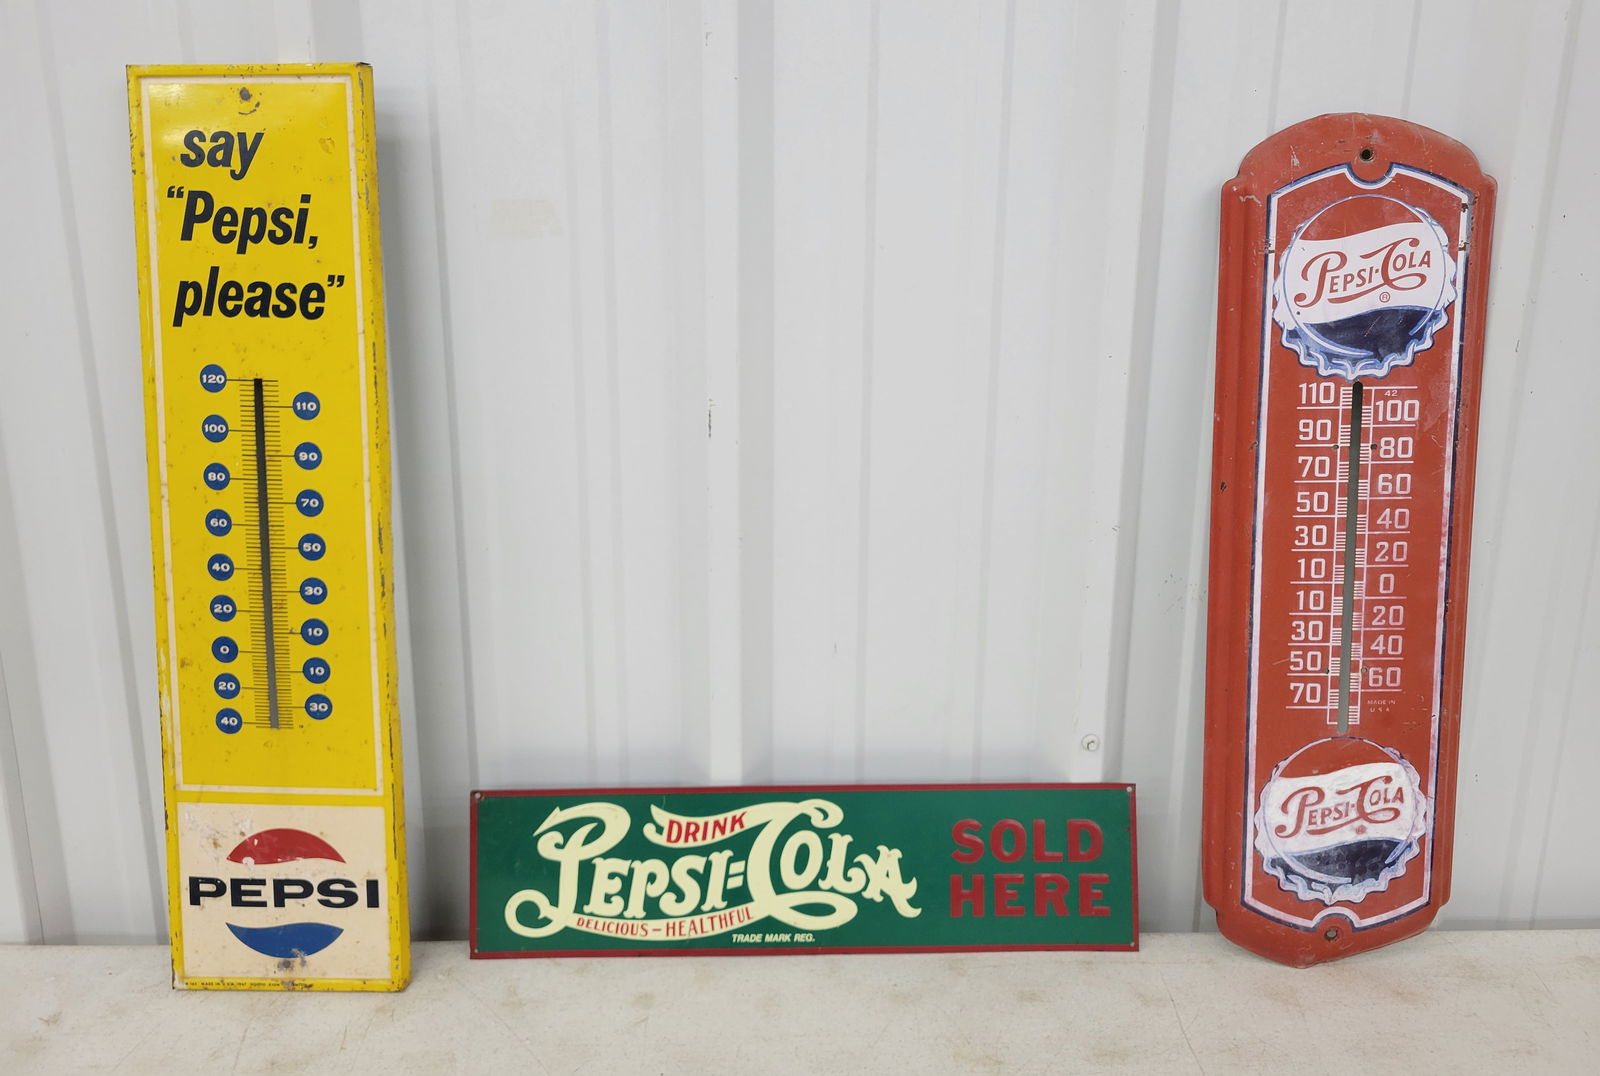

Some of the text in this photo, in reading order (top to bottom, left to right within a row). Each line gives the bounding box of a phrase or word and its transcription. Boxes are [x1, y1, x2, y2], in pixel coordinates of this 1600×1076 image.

[180, 130, 264, 180] say
[202, 374, 225, 384] 120
[1298, 382, 1335, 404] 110
[296, 401, 317, 411] 110
[1375, 399, 1420, 422] 100
[204, 423, 226, 433] 100
[1299, 419, 1332, 441] 90
[299, 451, 318, 461] 90
[1379, 437, 1414, 459] 80
[207, 472, 226, 481] 80
[1298, 456, 1331, 478] 70
[1377, 473, 1412, 495] 60
[301, 498, 319, 508] 70
[1296, 491, 1329, 513] 50
[210, 518, 228, 527] 60
[1376, 508, 1410, 529] 40
[1294, 525, 1327, 546] 30
[302, 543, 322, 552] 50
[1375, 541, 1408, 562] 20
[212, 562, 230, 572] 40
[1297, 558, 1326, 579] 10
[304, 586, 323, 596] 30
[1379, 573, 1395, 594] 0
[214, 604, 232, 613] 20
[1296, 590, 1325, 611] 10
[1371, 605, 1404, 626] 20
[307, 627, 323, 637] 10
[1291, 620, 1324, 641] 30
[220, 646, 230, 654] 0
[1370, 634, 1403, 655] 40
[309, 666, 325, 676] 10
[1289, 650, 1322, 671] 50
[218, 681, 236, 691] 20
[1368, 667, 1401, 688] 60
[1289, 682, 1321, 704] 70
[309, 702, 328, 712] 30
[220, 717, 238, 726] 40
[666, 811, 748, 844] DRINK
[950, 818, 1104, 864] SOLD
[188, 876, 380, 909] PEPSI
[949, 873, 1111, 918] HERE
[576, 916, 649, 937] DELICIOUS
[665, 906, 754, 938] HEALTHFUL
[732, 933, 763, 943] TRADE
[764, 932, 792, 943] MARK
